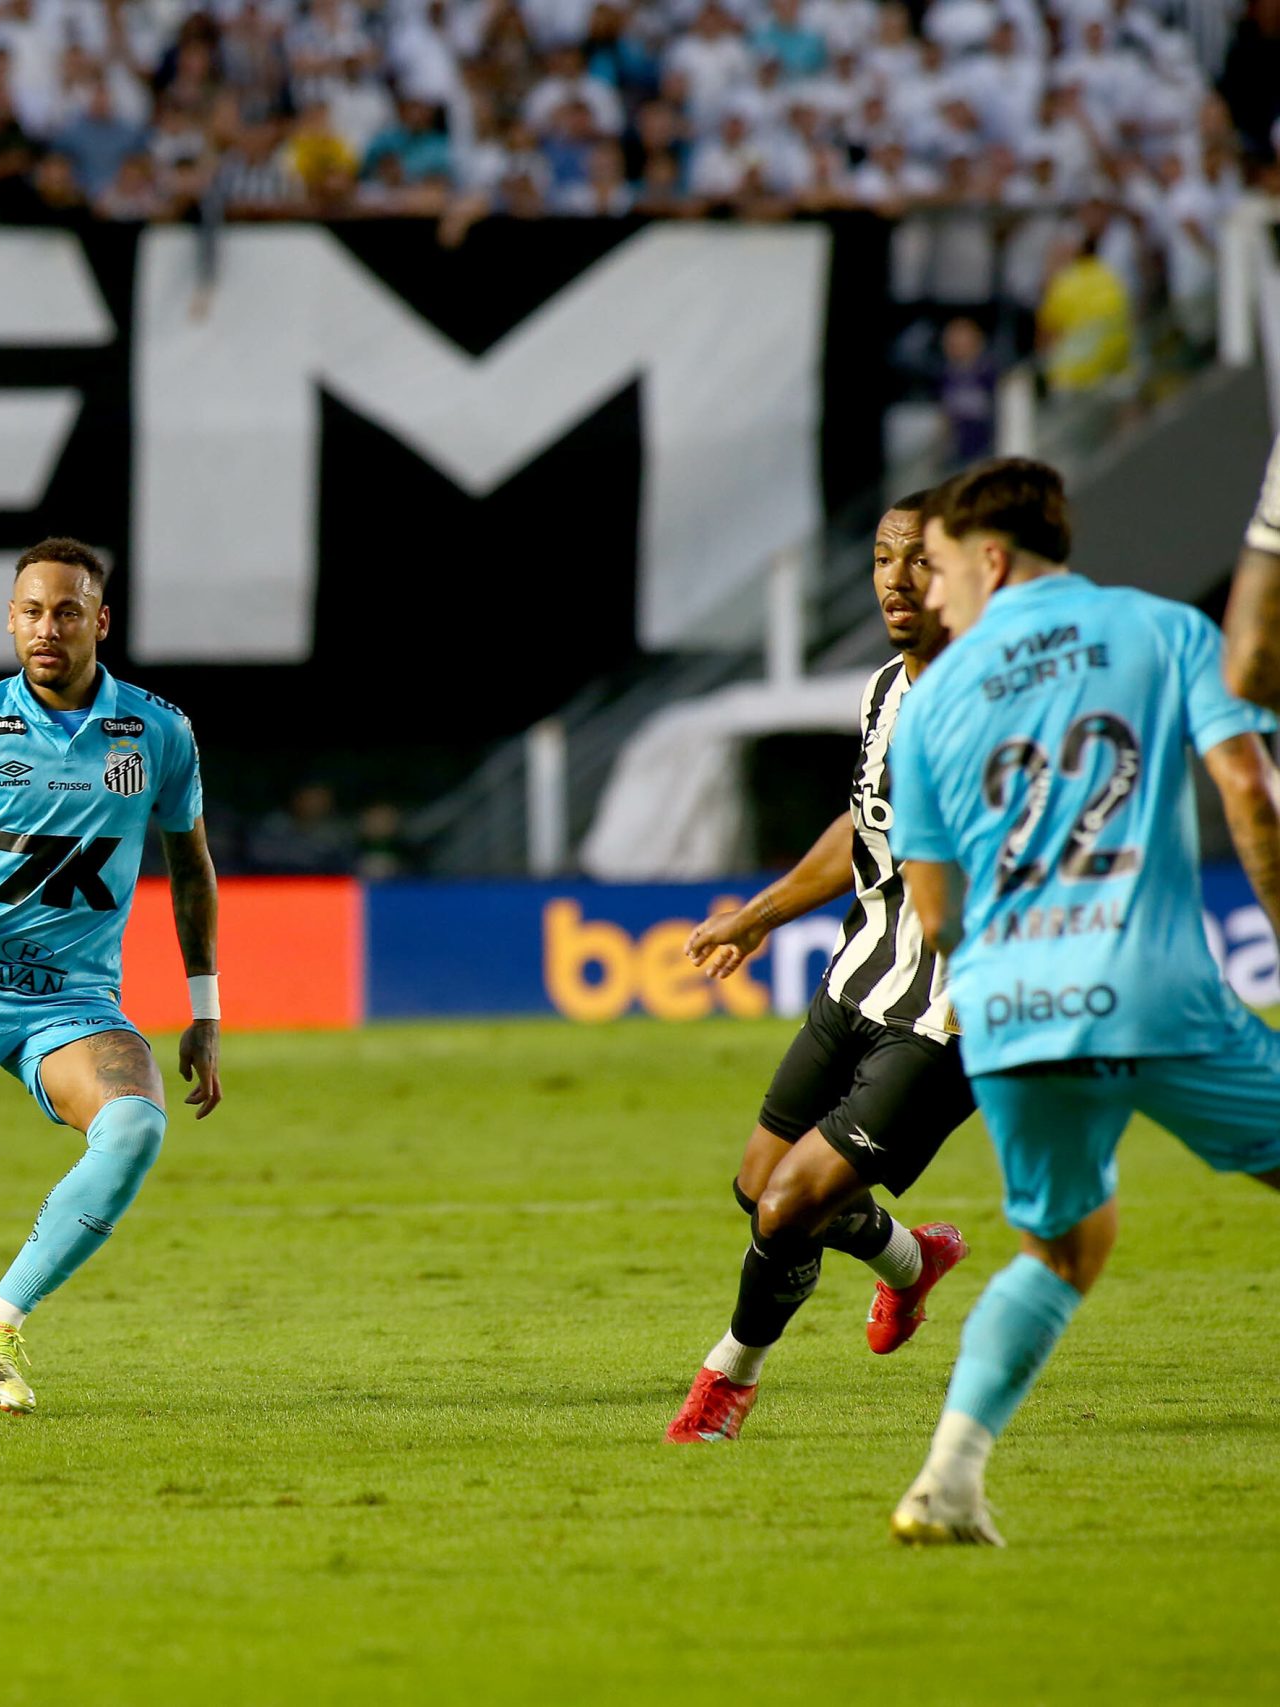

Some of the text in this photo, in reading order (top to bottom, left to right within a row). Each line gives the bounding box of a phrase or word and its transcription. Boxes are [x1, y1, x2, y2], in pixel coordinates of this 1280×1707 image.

[1004, 624, 1078, 662] VIVA
[982, 643, 1109, 701] SORTE
[103, 720, 143, 733] Canção
[983, 710, 1139, 900] 22
[985, 979, 1118, 1036] placo
